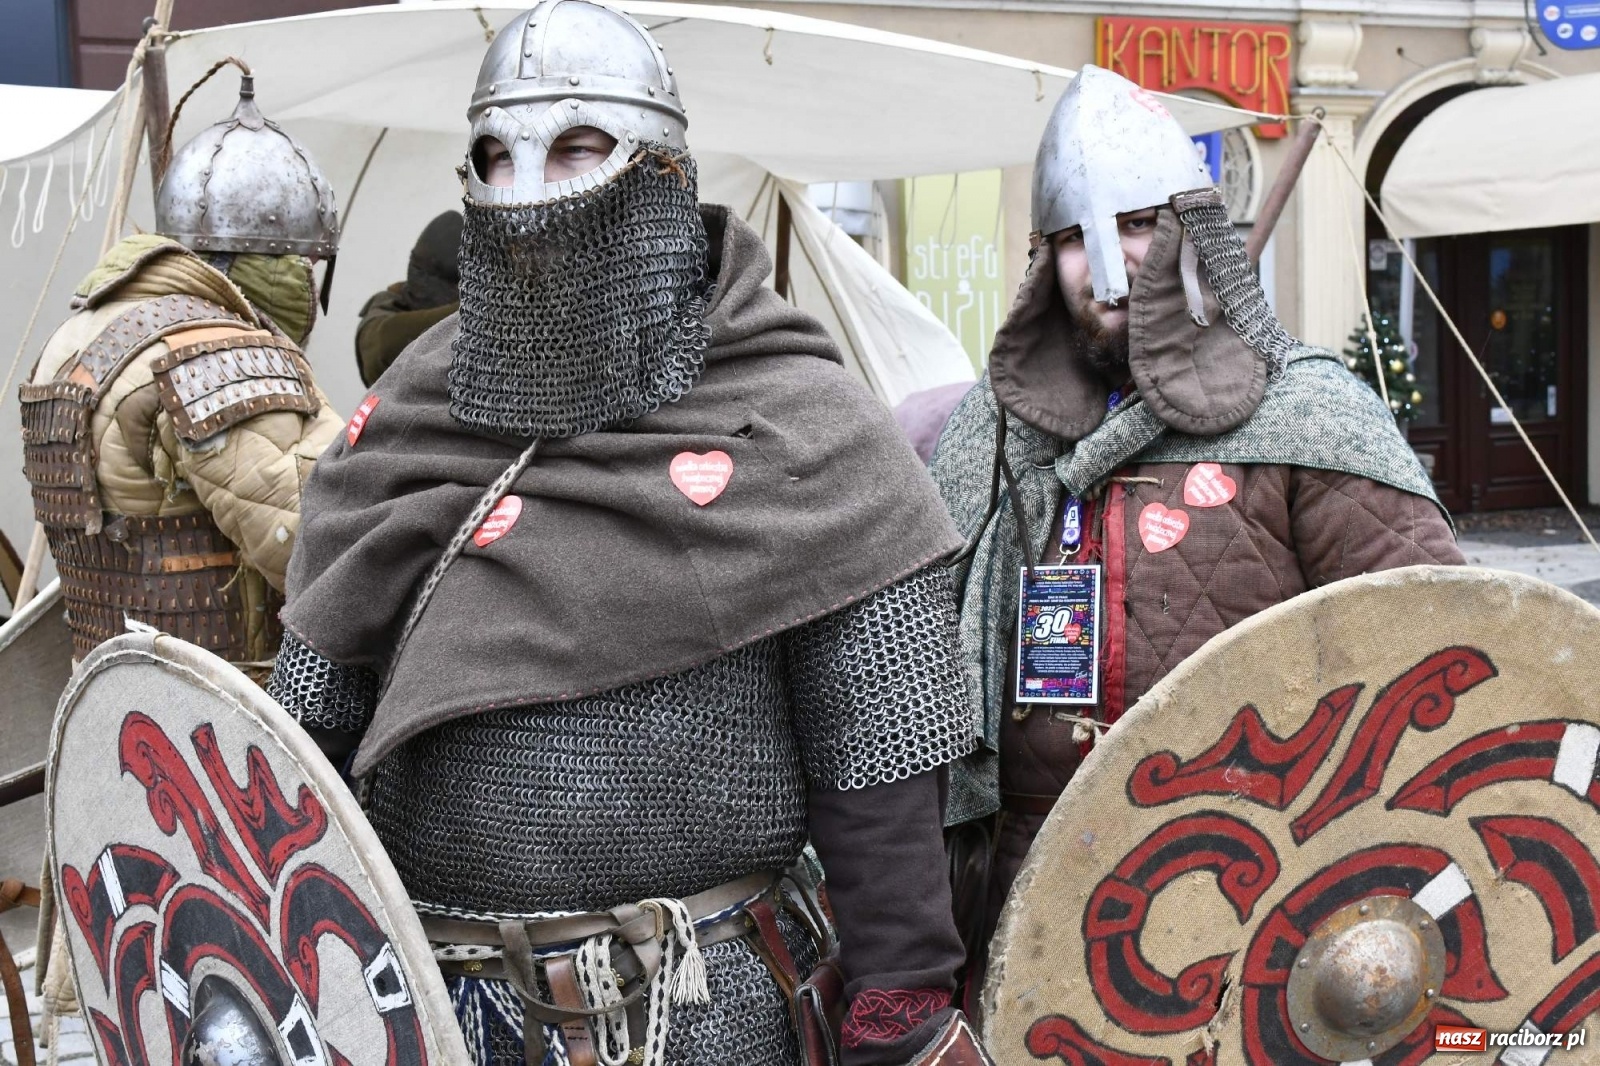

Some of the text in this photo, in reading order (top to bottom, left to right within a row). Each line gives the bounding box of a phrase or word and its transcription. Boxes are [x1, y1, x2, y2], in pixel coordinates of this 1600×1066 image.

[1107, 22, 1292, 133] KANTOR
[913, 235, 999, 280] strefa
[1033, 607, 1073, 640] 30
